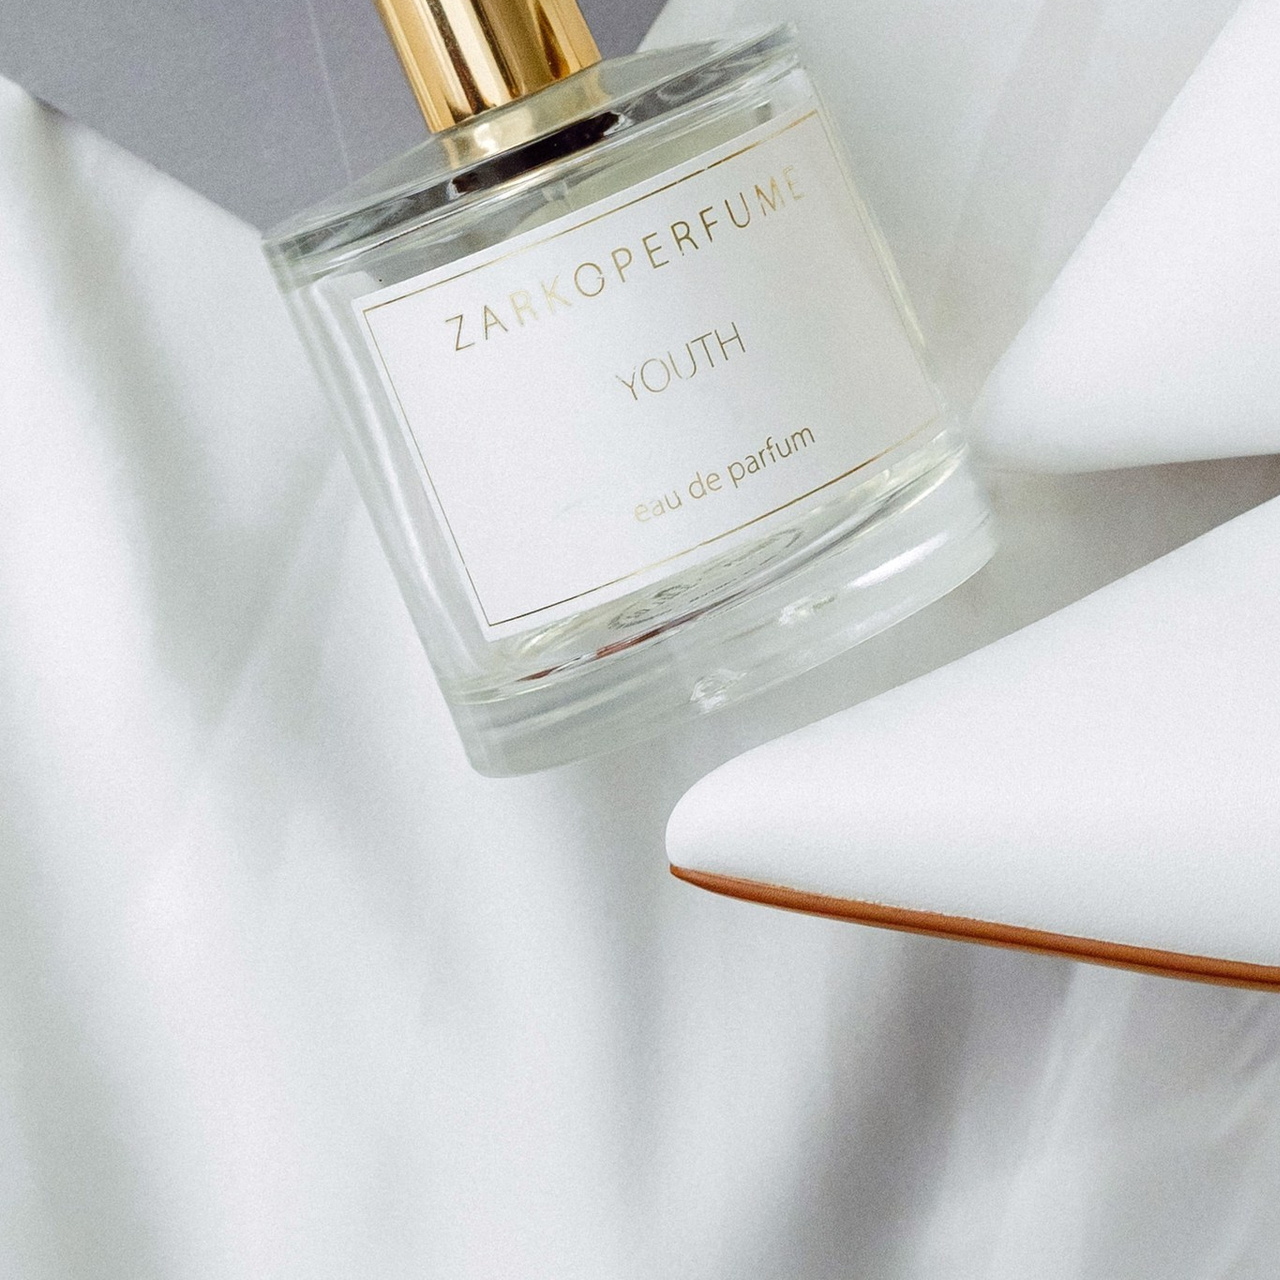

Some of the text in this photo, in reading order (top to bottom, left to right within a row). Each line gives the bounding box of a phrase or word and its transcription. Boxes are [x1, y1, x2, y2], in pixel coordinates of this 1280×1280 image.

[444, 165, 805, 352] ZARKOPERFUME
[615, 321, 746, 401] YOUTH
[633, 427, 816, 522] eau de parfum
